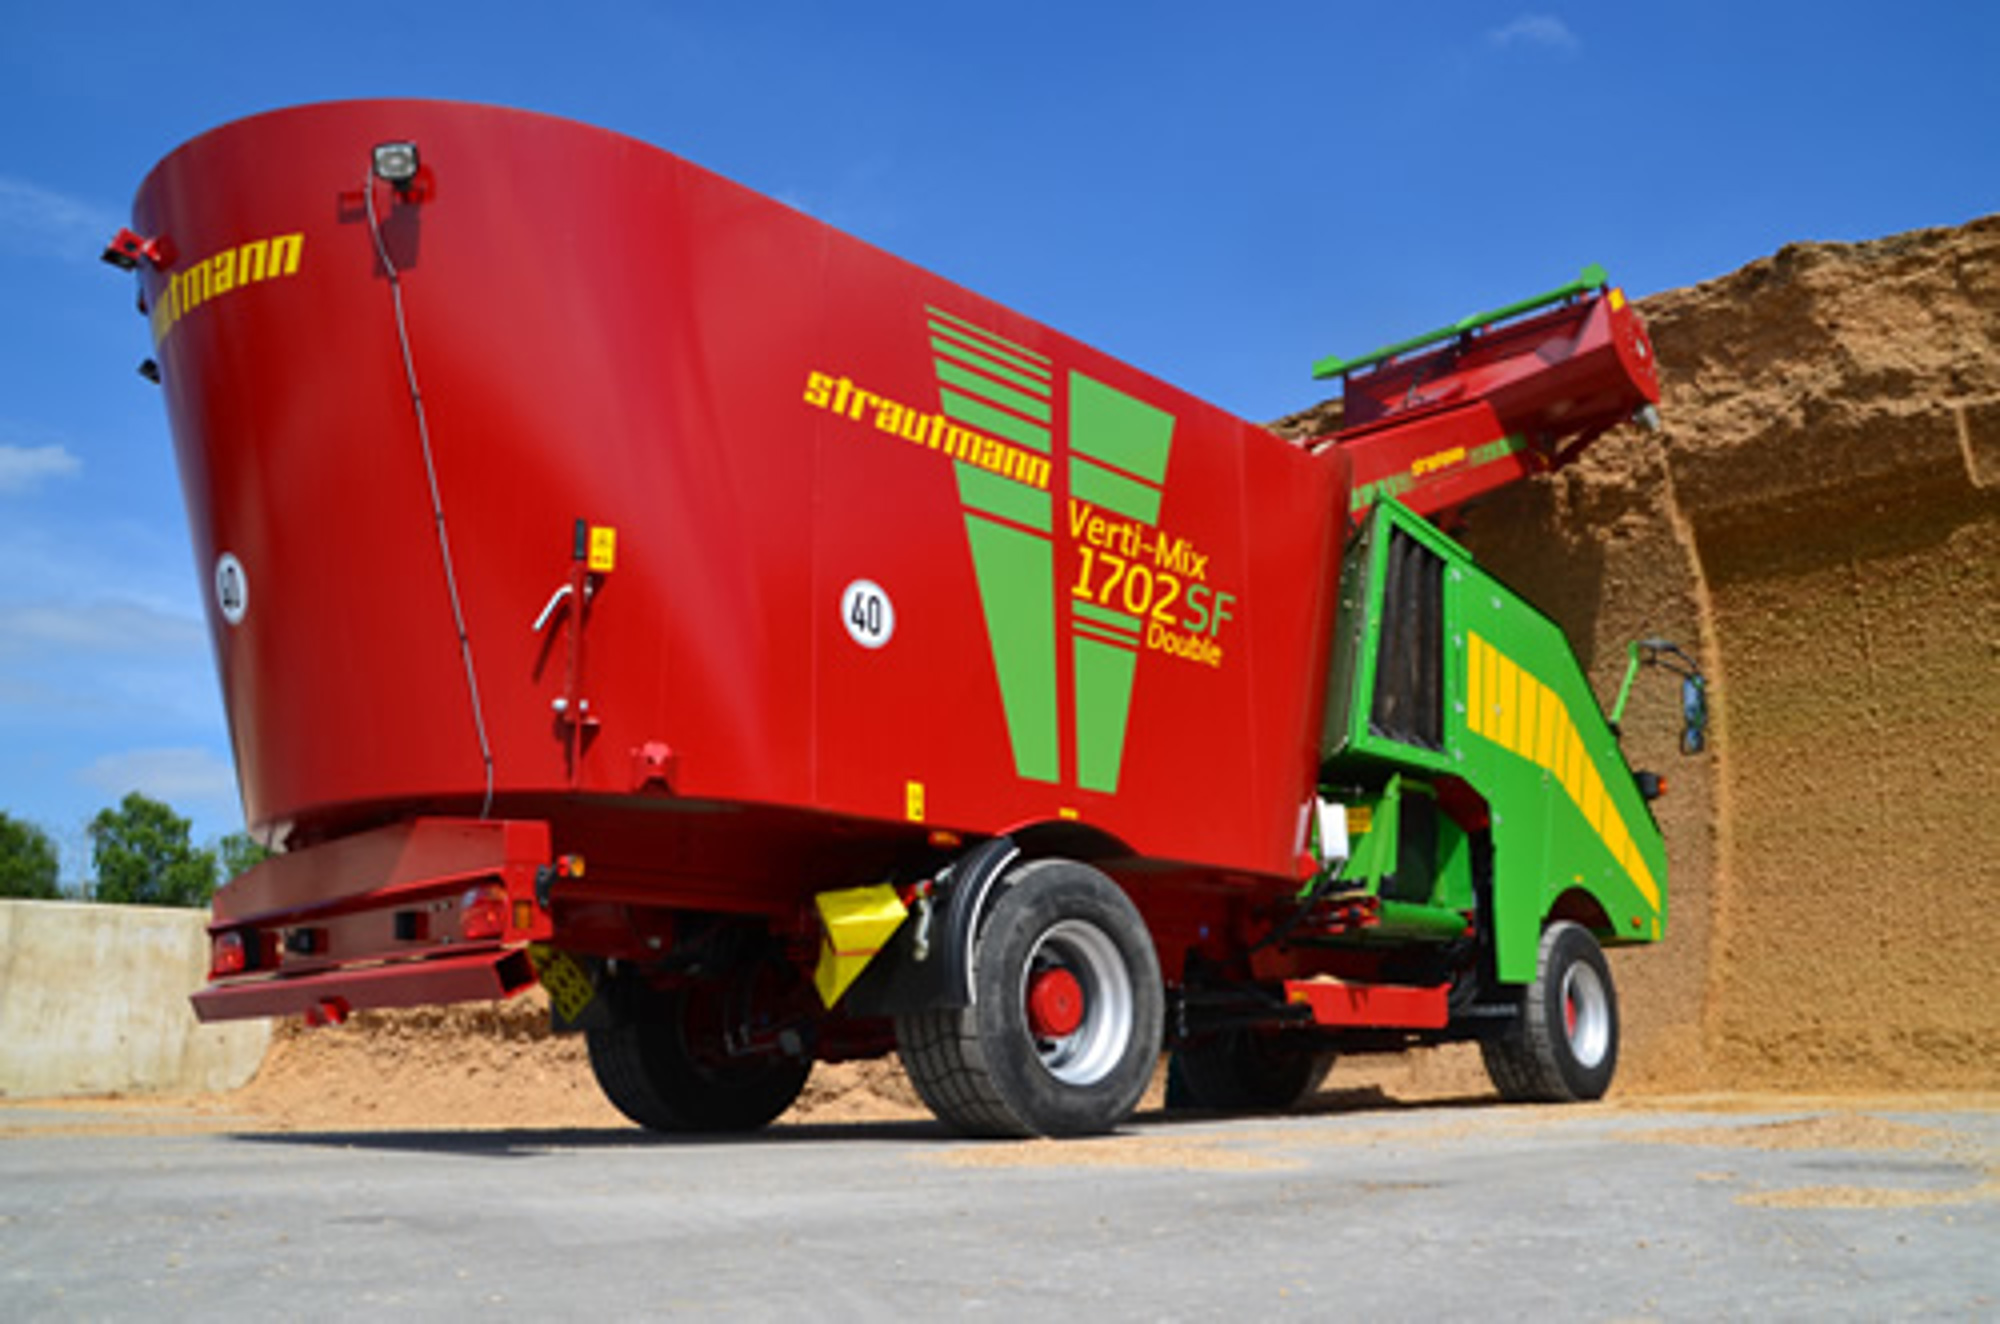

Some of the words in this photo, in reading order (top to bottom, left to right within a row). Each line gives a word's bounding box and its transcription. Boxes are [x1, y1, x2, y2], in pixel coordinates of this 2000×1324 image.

[803, 370, 1052, 490] strautmann
[1068, 499, 1208, 581] Verti-Mix
[851, 591, 881, 637] 40
[1071, 545, 1181, 625] 1702
[1183, 584, 1236, 637] SF
[1146, 620, 1222, 668] Double
